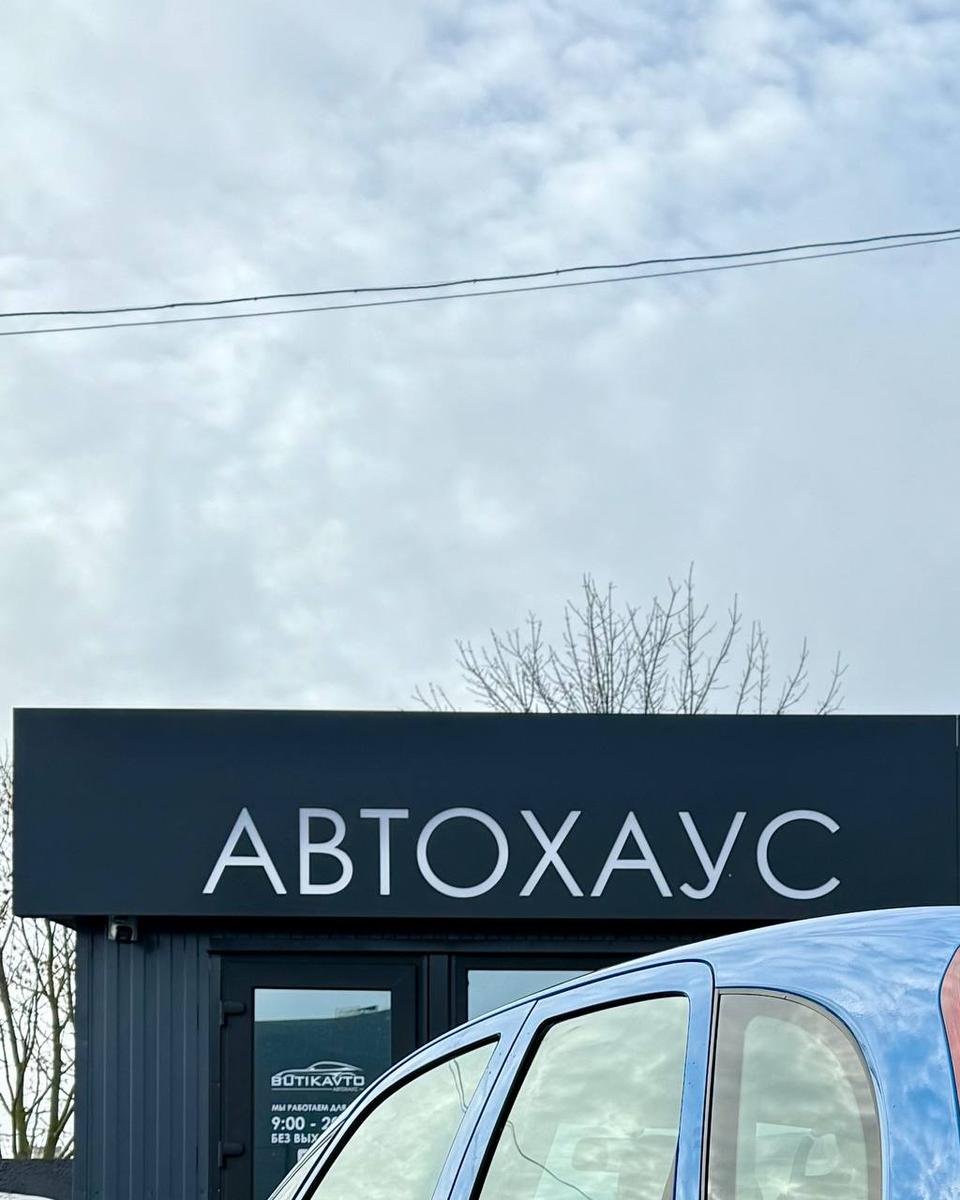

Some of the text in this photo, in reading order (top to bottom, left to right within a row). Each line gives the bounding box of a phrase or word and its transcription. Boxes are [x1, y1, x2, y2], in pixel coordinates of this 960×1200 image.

[202, 807, 841, 899] АВТОХАУС
[271, 1075, 365, 1087] BUTIKAVTO
[271, 1104, 286, 1112] МЫ
[287, 1104, 329, 1112] РАБОТАЕМ
[271, 1116, 305, 1131] 9:00
[271, 1133, 291, 1144] БЕЗ
